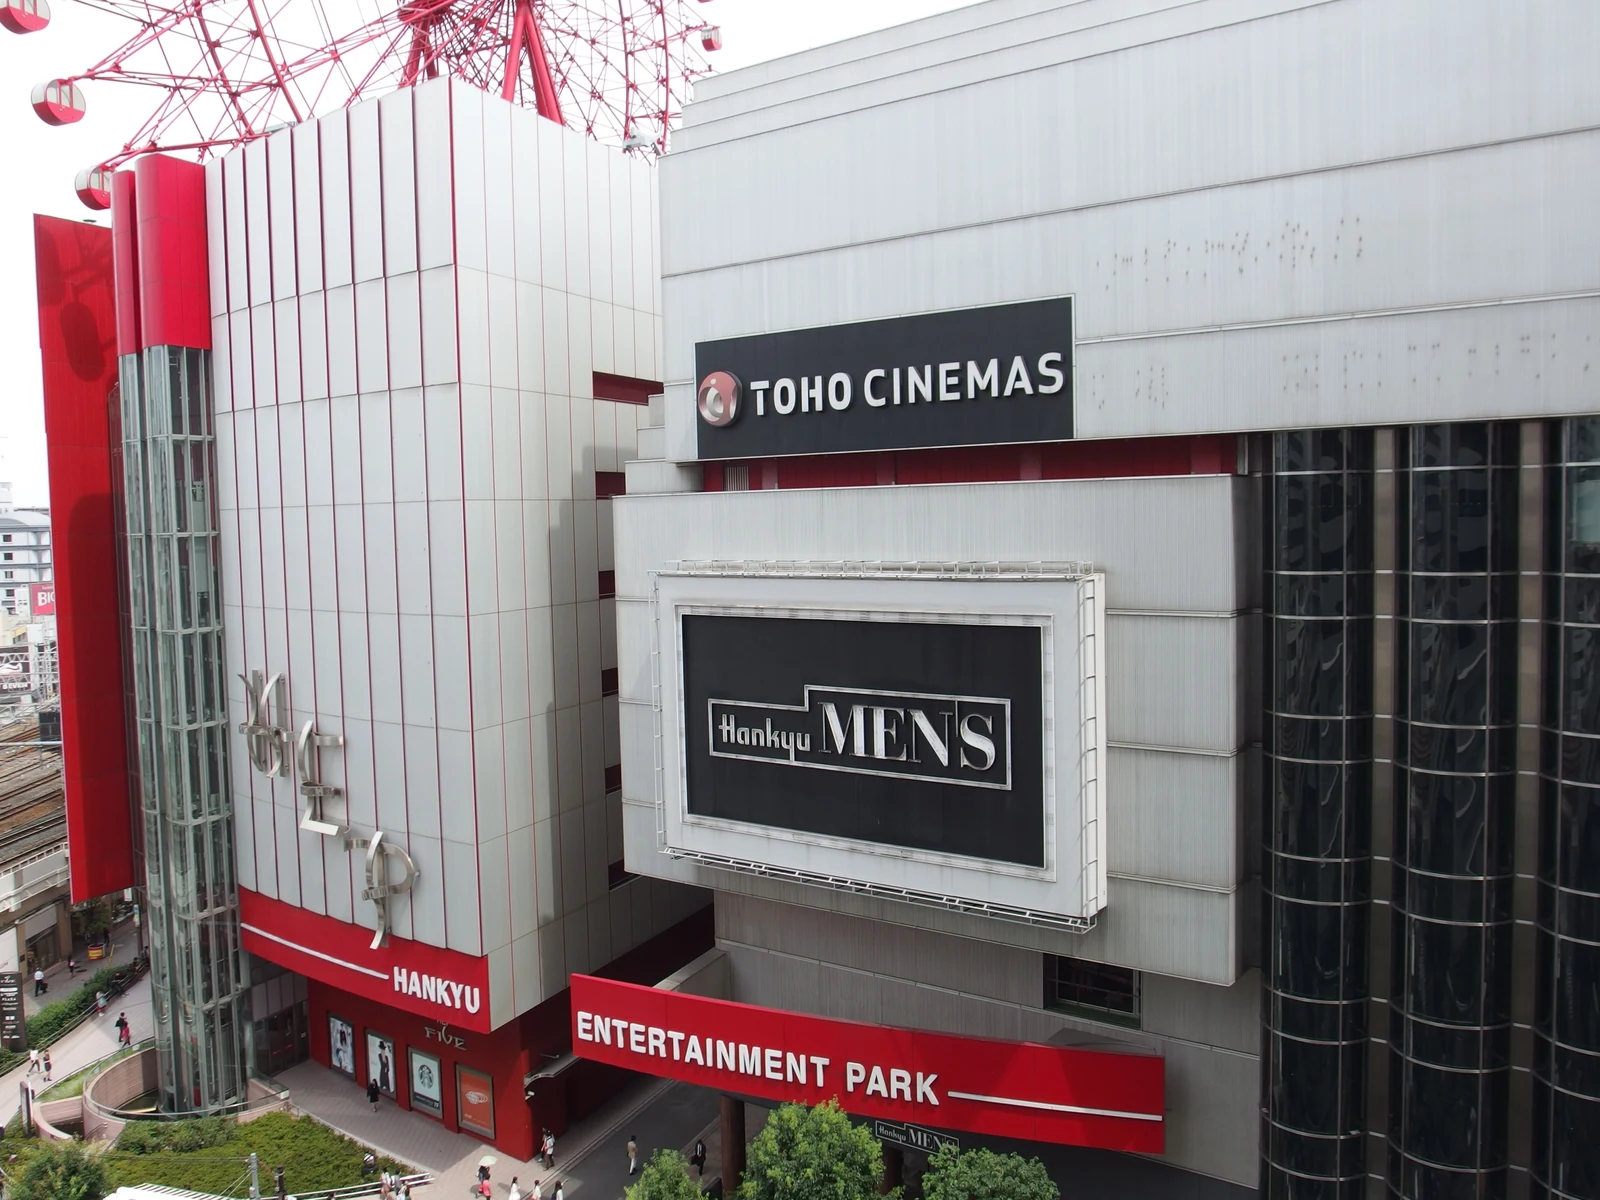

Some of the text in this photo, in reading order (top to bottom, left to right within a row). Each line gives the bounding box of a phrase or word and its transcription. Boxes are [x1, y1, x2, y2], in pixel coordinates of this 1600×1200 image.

[750, 352, 1065, 416] TOHO CINEMAS
[718, 700, 996, 772] Hankyu MEN'S
[393, 966, 480, 1014] HANKYU
[424, 1025, 467, 1051] FIVE
[577, 1010, 940, 1106] ENTERTAINMENT PARK
[879, 1125, 907, 1143] Hankyu
